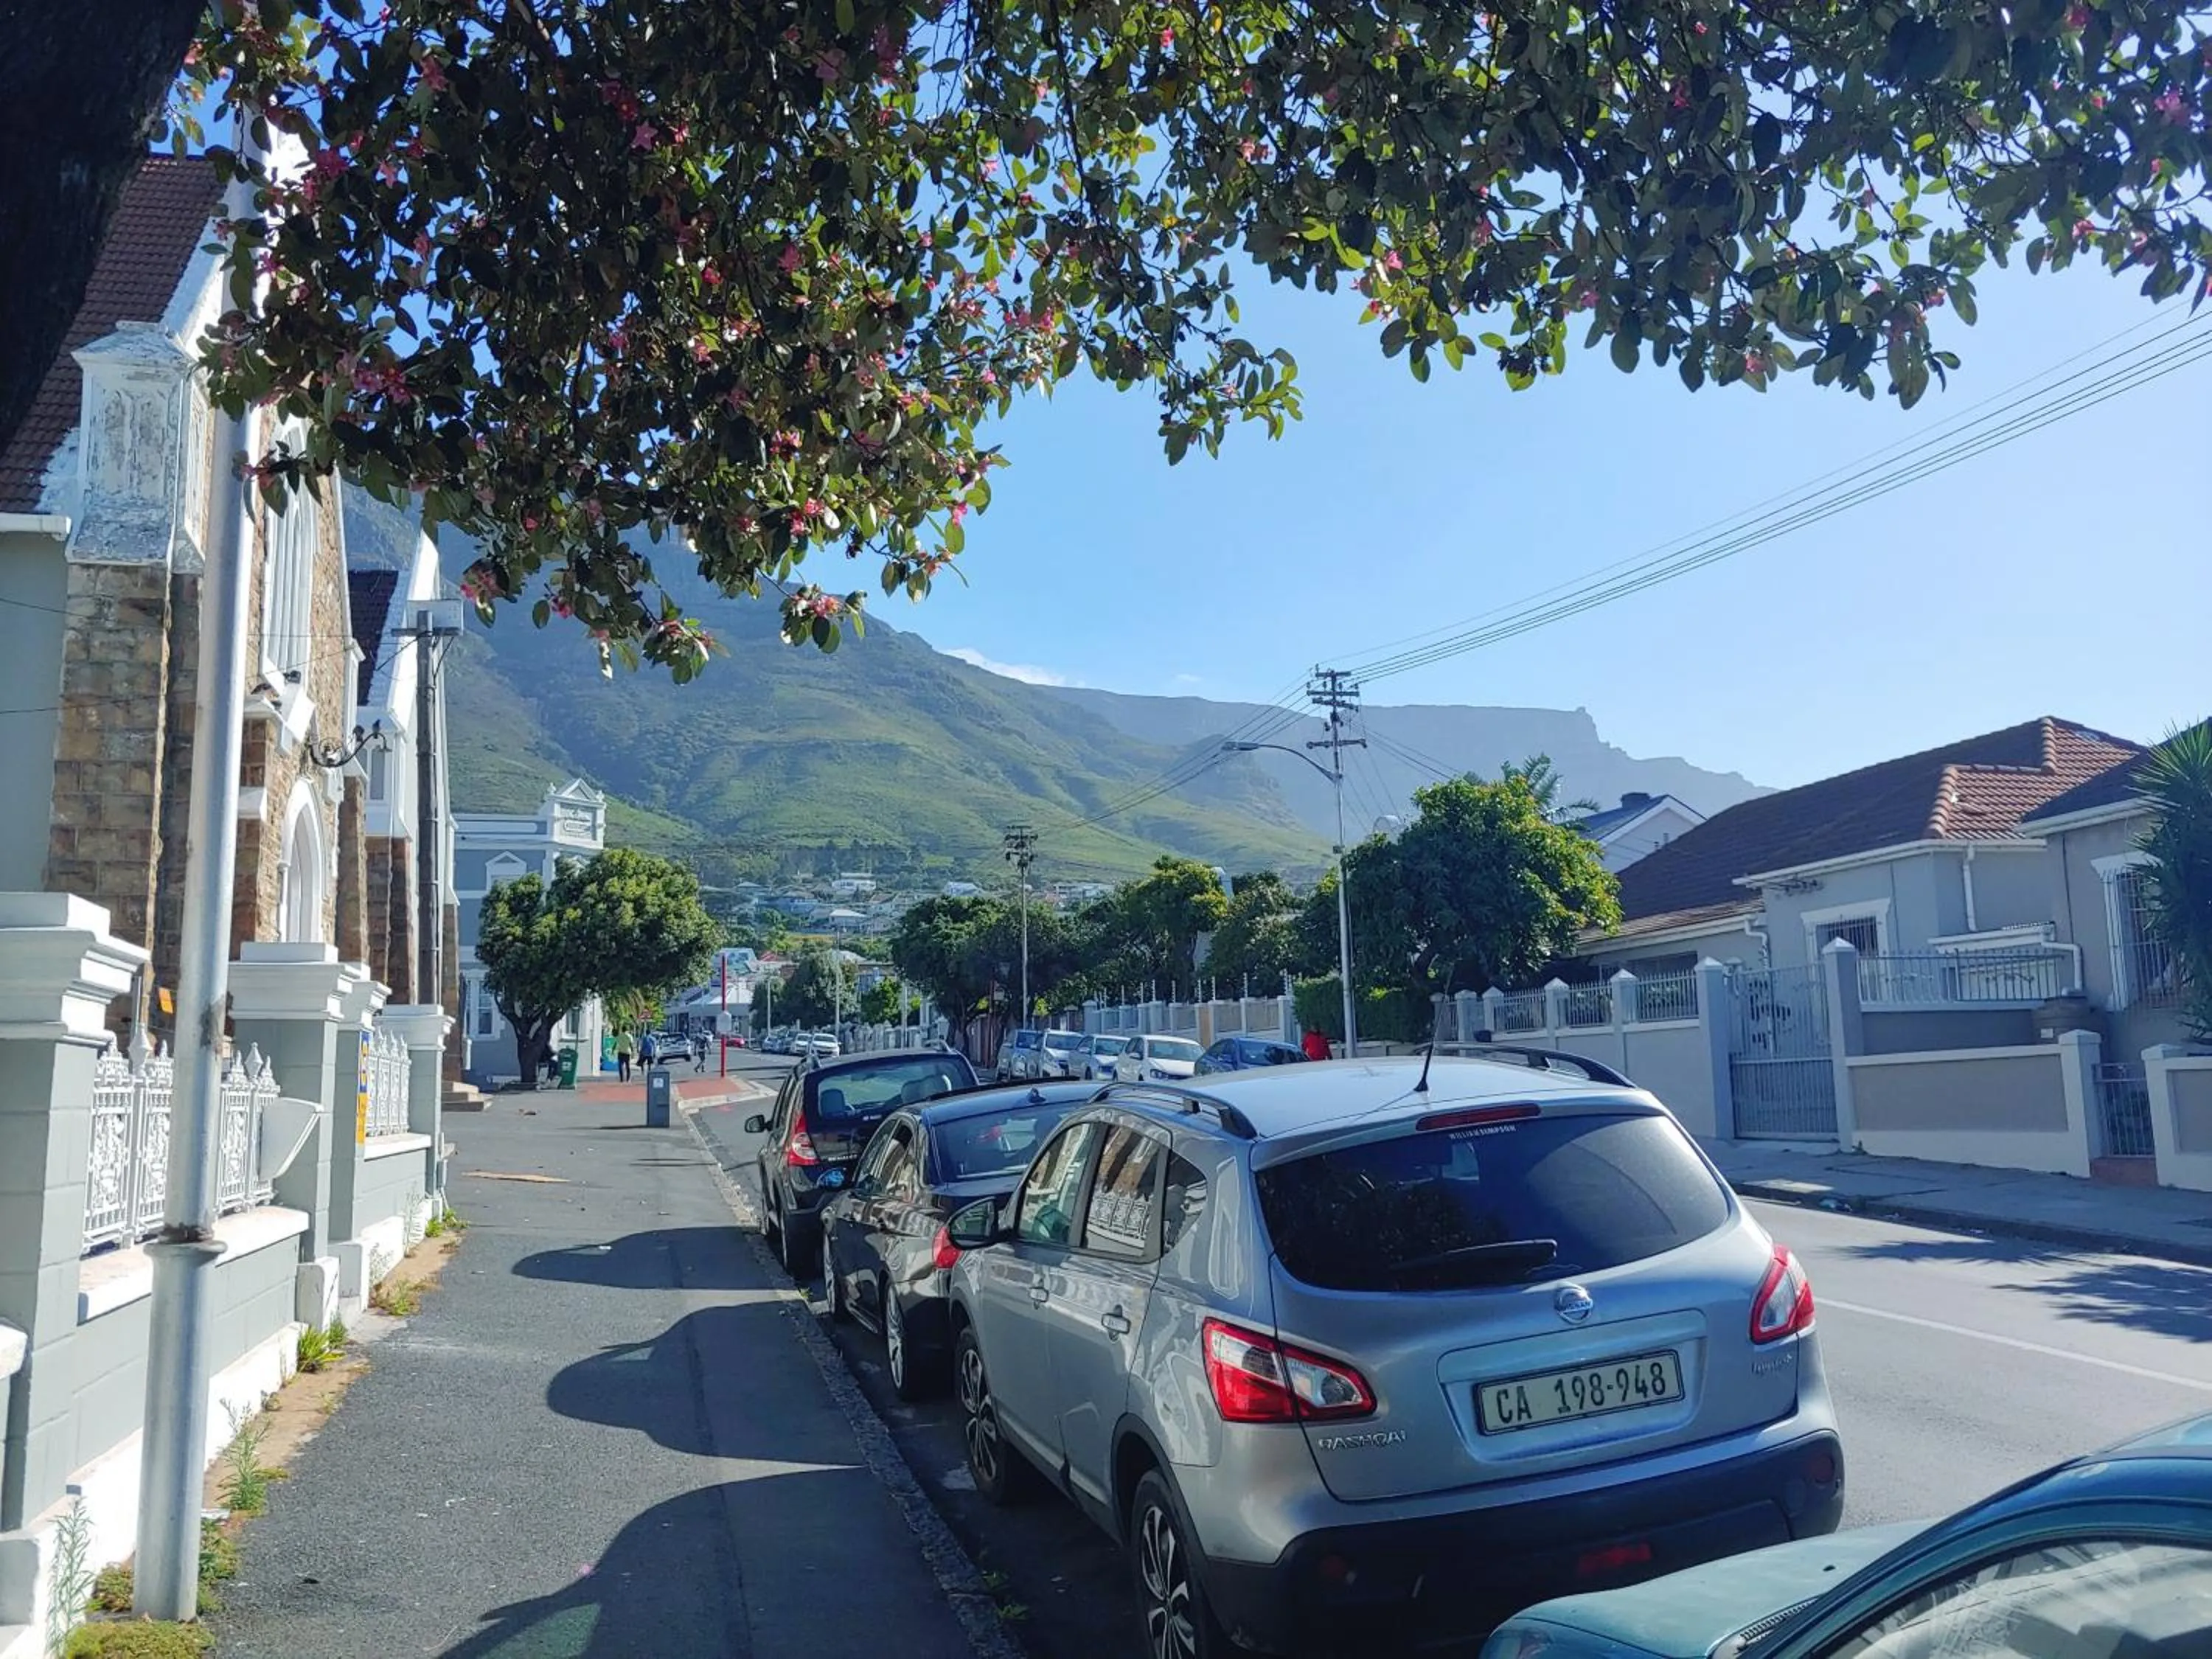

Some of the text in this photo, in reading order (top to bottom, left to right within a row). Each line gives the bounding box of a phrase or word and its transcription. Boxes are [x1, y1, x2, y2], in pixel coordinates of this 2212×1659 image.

[1496, 1362, 1666, 1424] CA 198-948
[1318, 1430, 1406, 1450] QASHQAI
